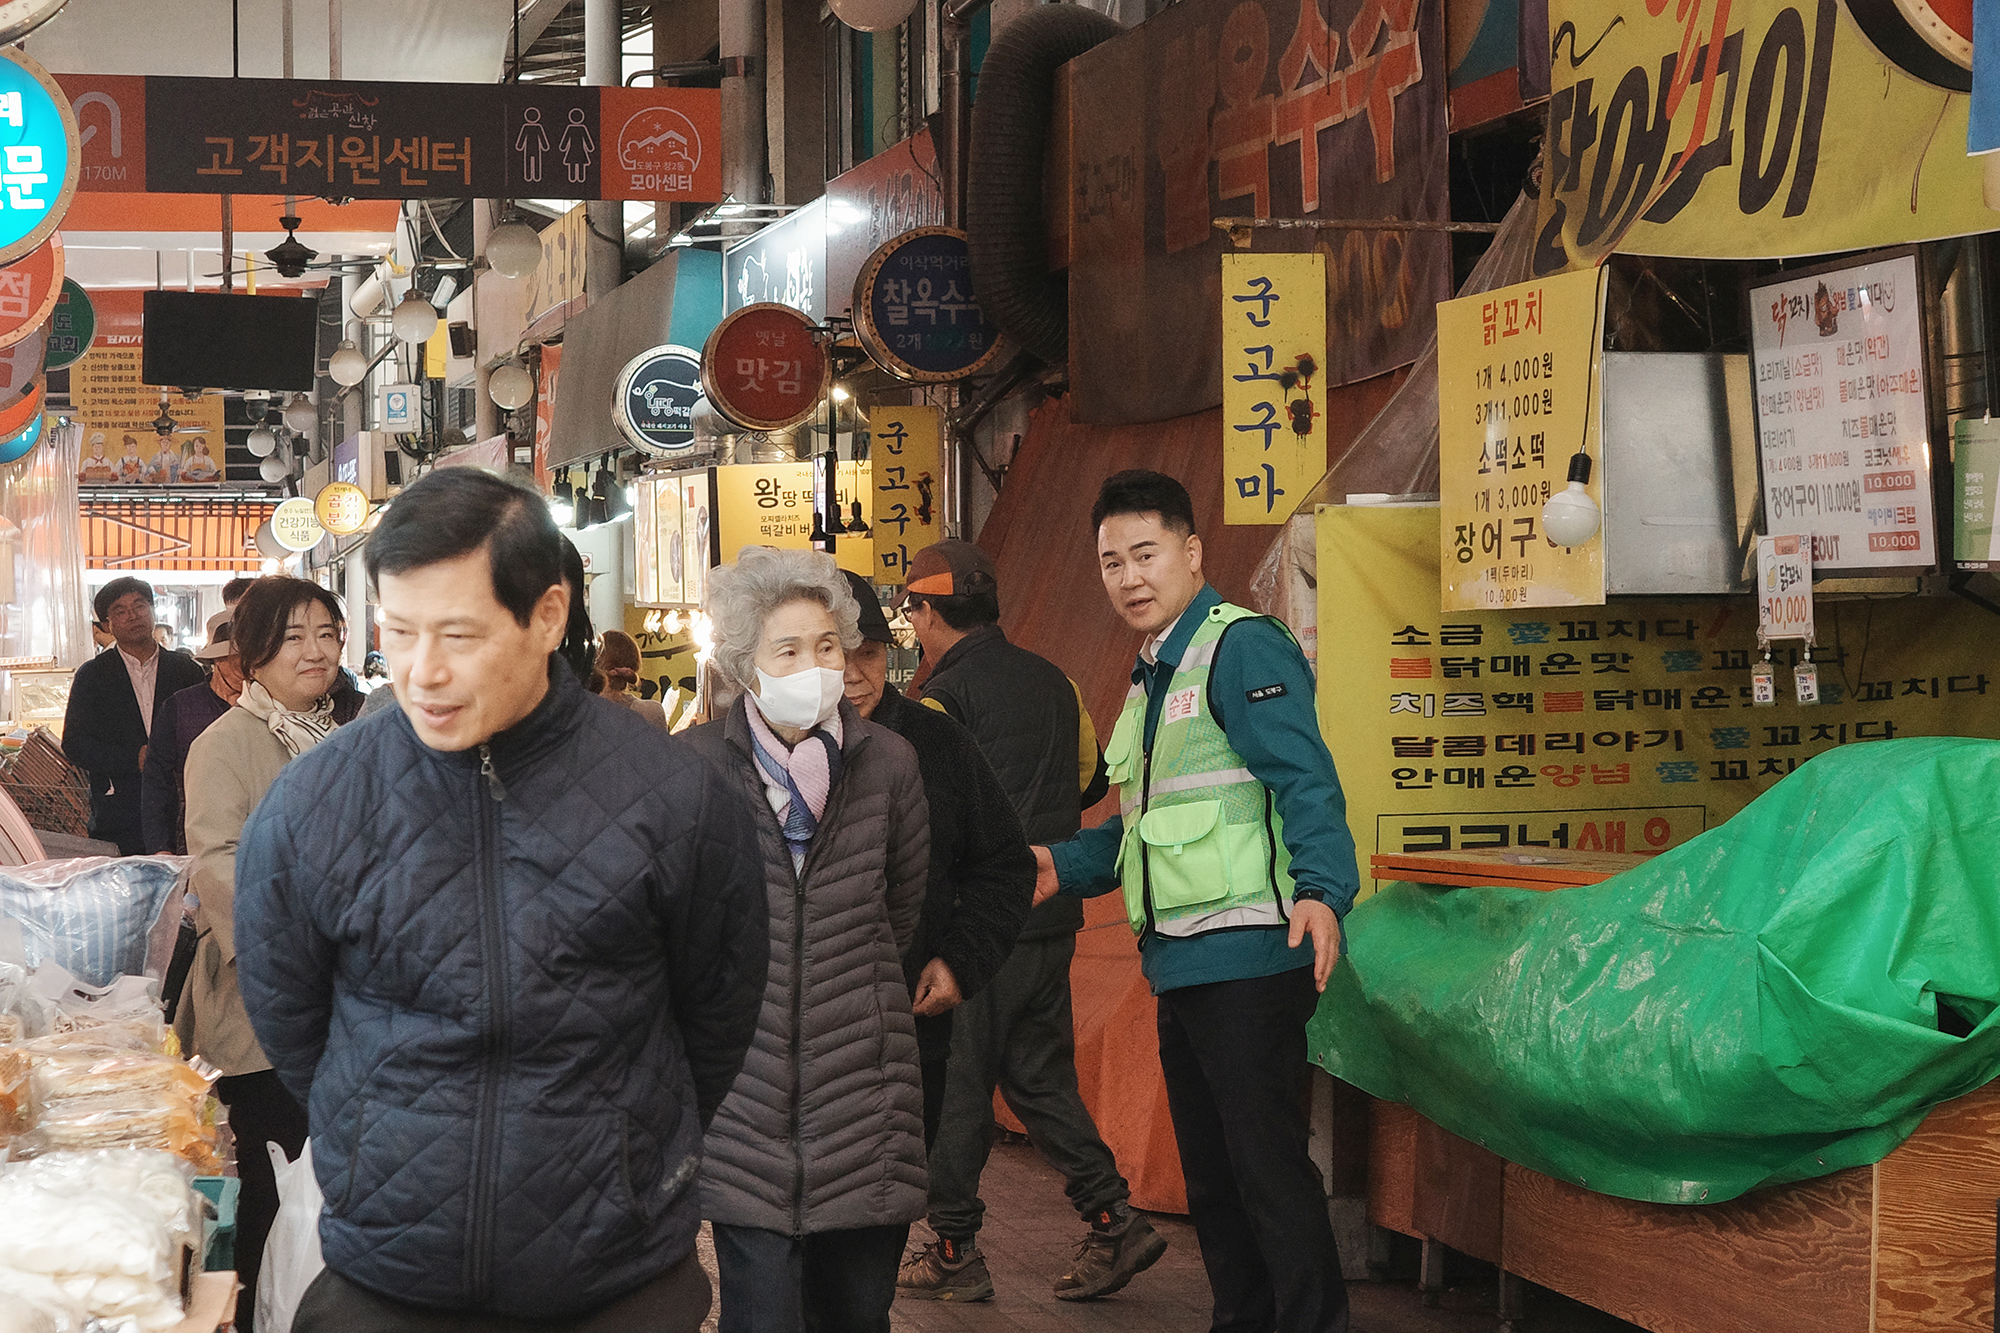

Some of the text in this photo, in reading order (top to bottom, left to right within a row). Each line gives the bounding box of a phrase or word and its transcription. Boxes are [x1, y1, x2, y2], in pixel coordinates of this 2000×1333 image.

[196, 133, 472, 186] 고객지원센터
[663, 161, 686, 172] 창2동
[0, 145, 49, 210] 문
[630, 174, 693, 192] 모아센터
[1482, 288, 1543, 346] 닭꼬치
[756, 330, 788, 348] 옛날
[896, 333, 922, 351] 2개
[736, 358, 801, 395] 맛김
[1476, 352, 1553, 390] 1개 4,000원
[1232, 276, 1285, 514] 군고구마
[1842, 411, 1898, 440] 치즈불매운맛
[1477, 431, 1546, 475] 소떡소떡
[1867, 474, 1913, 489] 10.000
[877, 421, 912, 577] 군고구마
[1474, 480, 1551, 513] 1개 3,000원
[1771, 481, 1822, 519] 장어구이
[279, 517, 320, 529] 건강기능
[1867, 505, 1917, 526] 베이비크랩
[289, 530, 310, 542] 식품
[760, 524, 796, 538] 떡갈비
[1454, 516, 1572, 563] 장어구
[1871, 538, 1917, 549] 10.000
[1485, 563, 1534, 583] 1팩(두마리)
[1485, 587, 1528, 604] 10,000원
[1768, 595, 1808, 630] 10,000
[1391, 624, 1484, 645] 소금
[1390, 653, 1635, 678] 불닭매운맛
[1168, 690, 1196, 719] 순찰
[1391, 763, 1631, 790] 안매운양념
